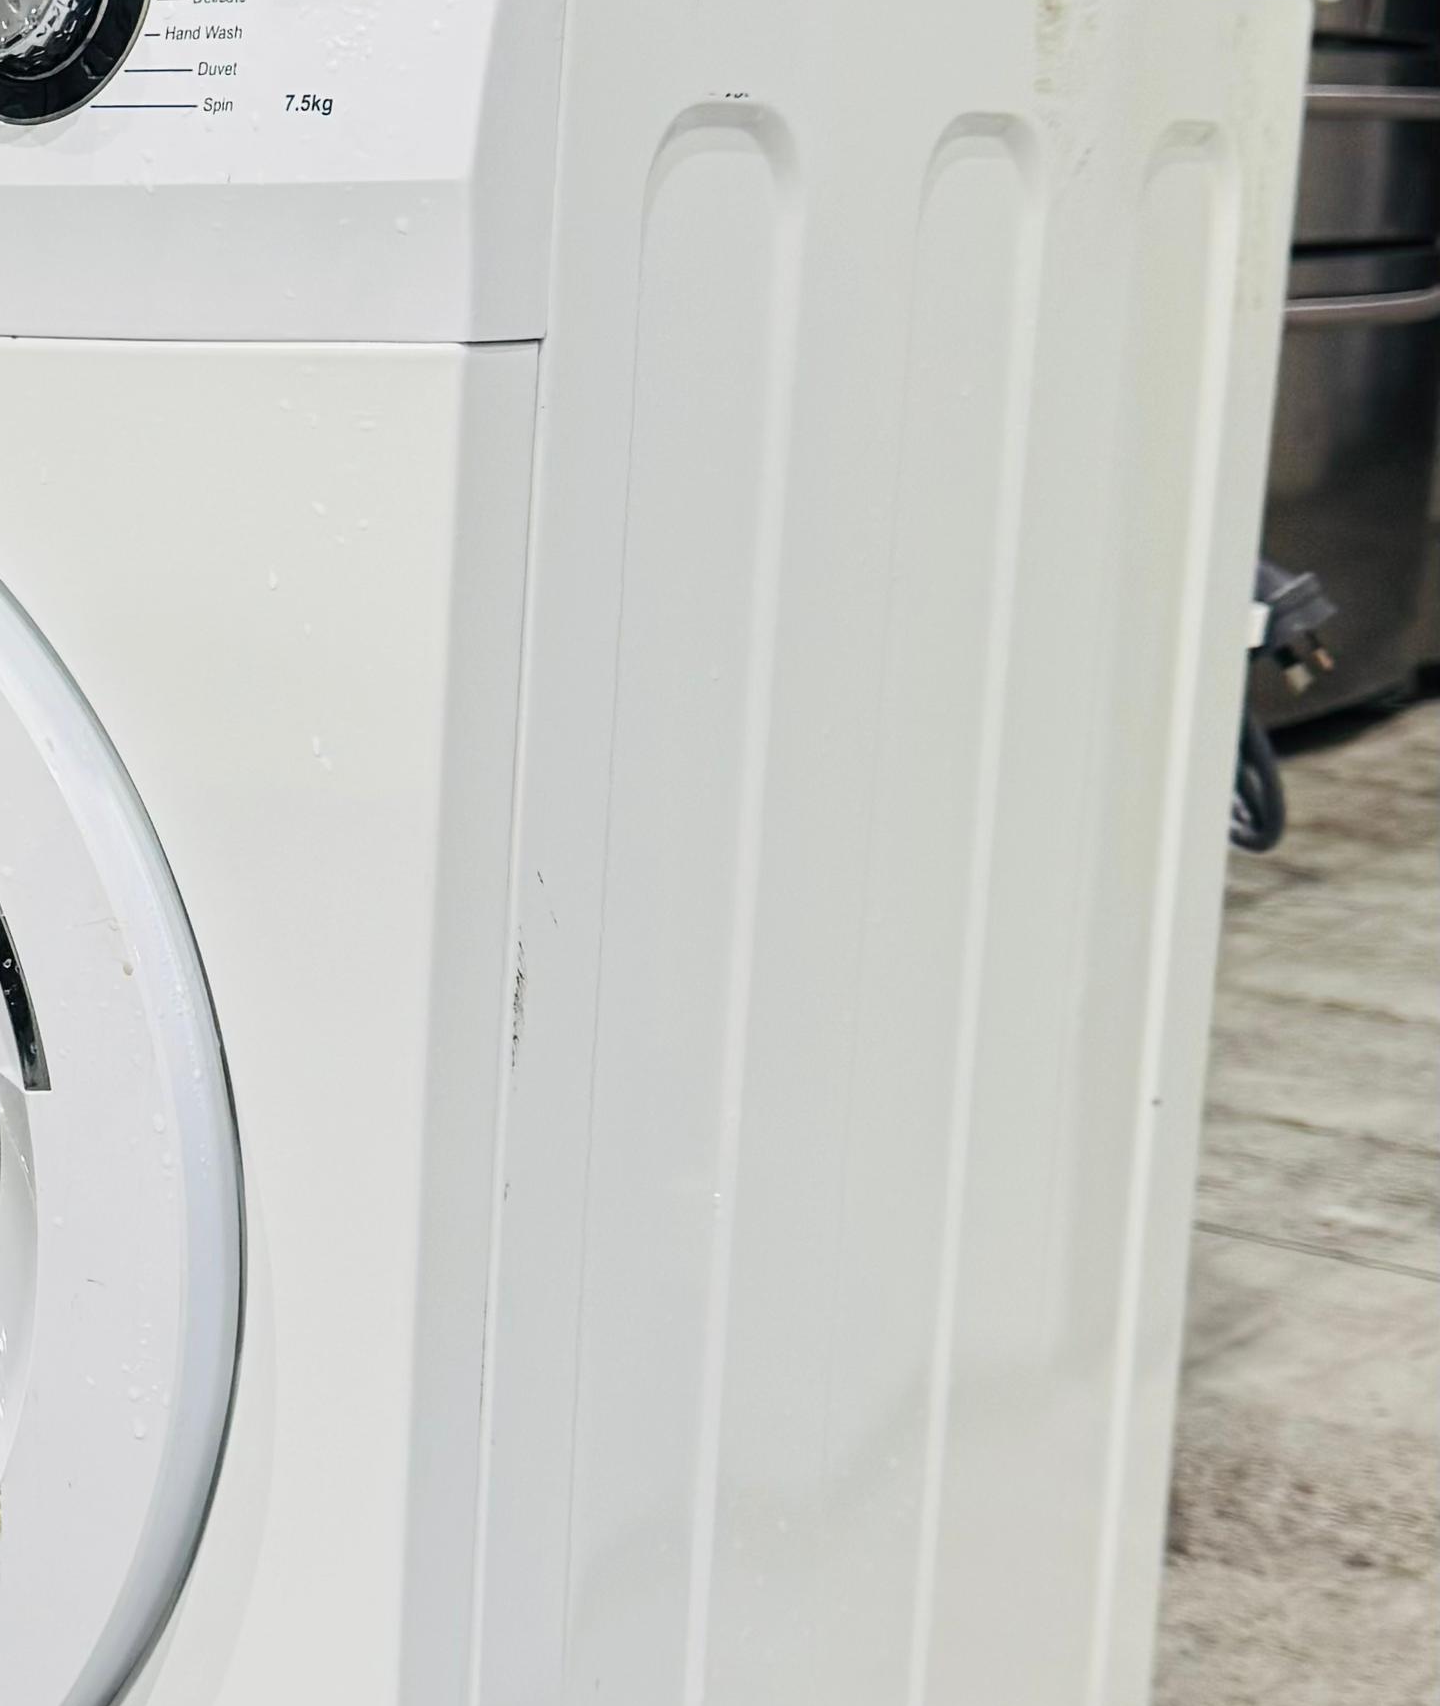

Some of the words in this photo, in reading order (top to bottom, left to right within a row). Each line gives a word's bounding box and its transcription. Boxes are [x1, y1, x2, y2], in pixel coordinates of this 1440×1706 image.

[165, 25, 201, 40] Hand
[205, 24, 243, 39] Wash
[197, 61, 237, 76] Duvet
[203, 97, 233, 115] Spin
[285, 94, 334, 116] 7.5kg
